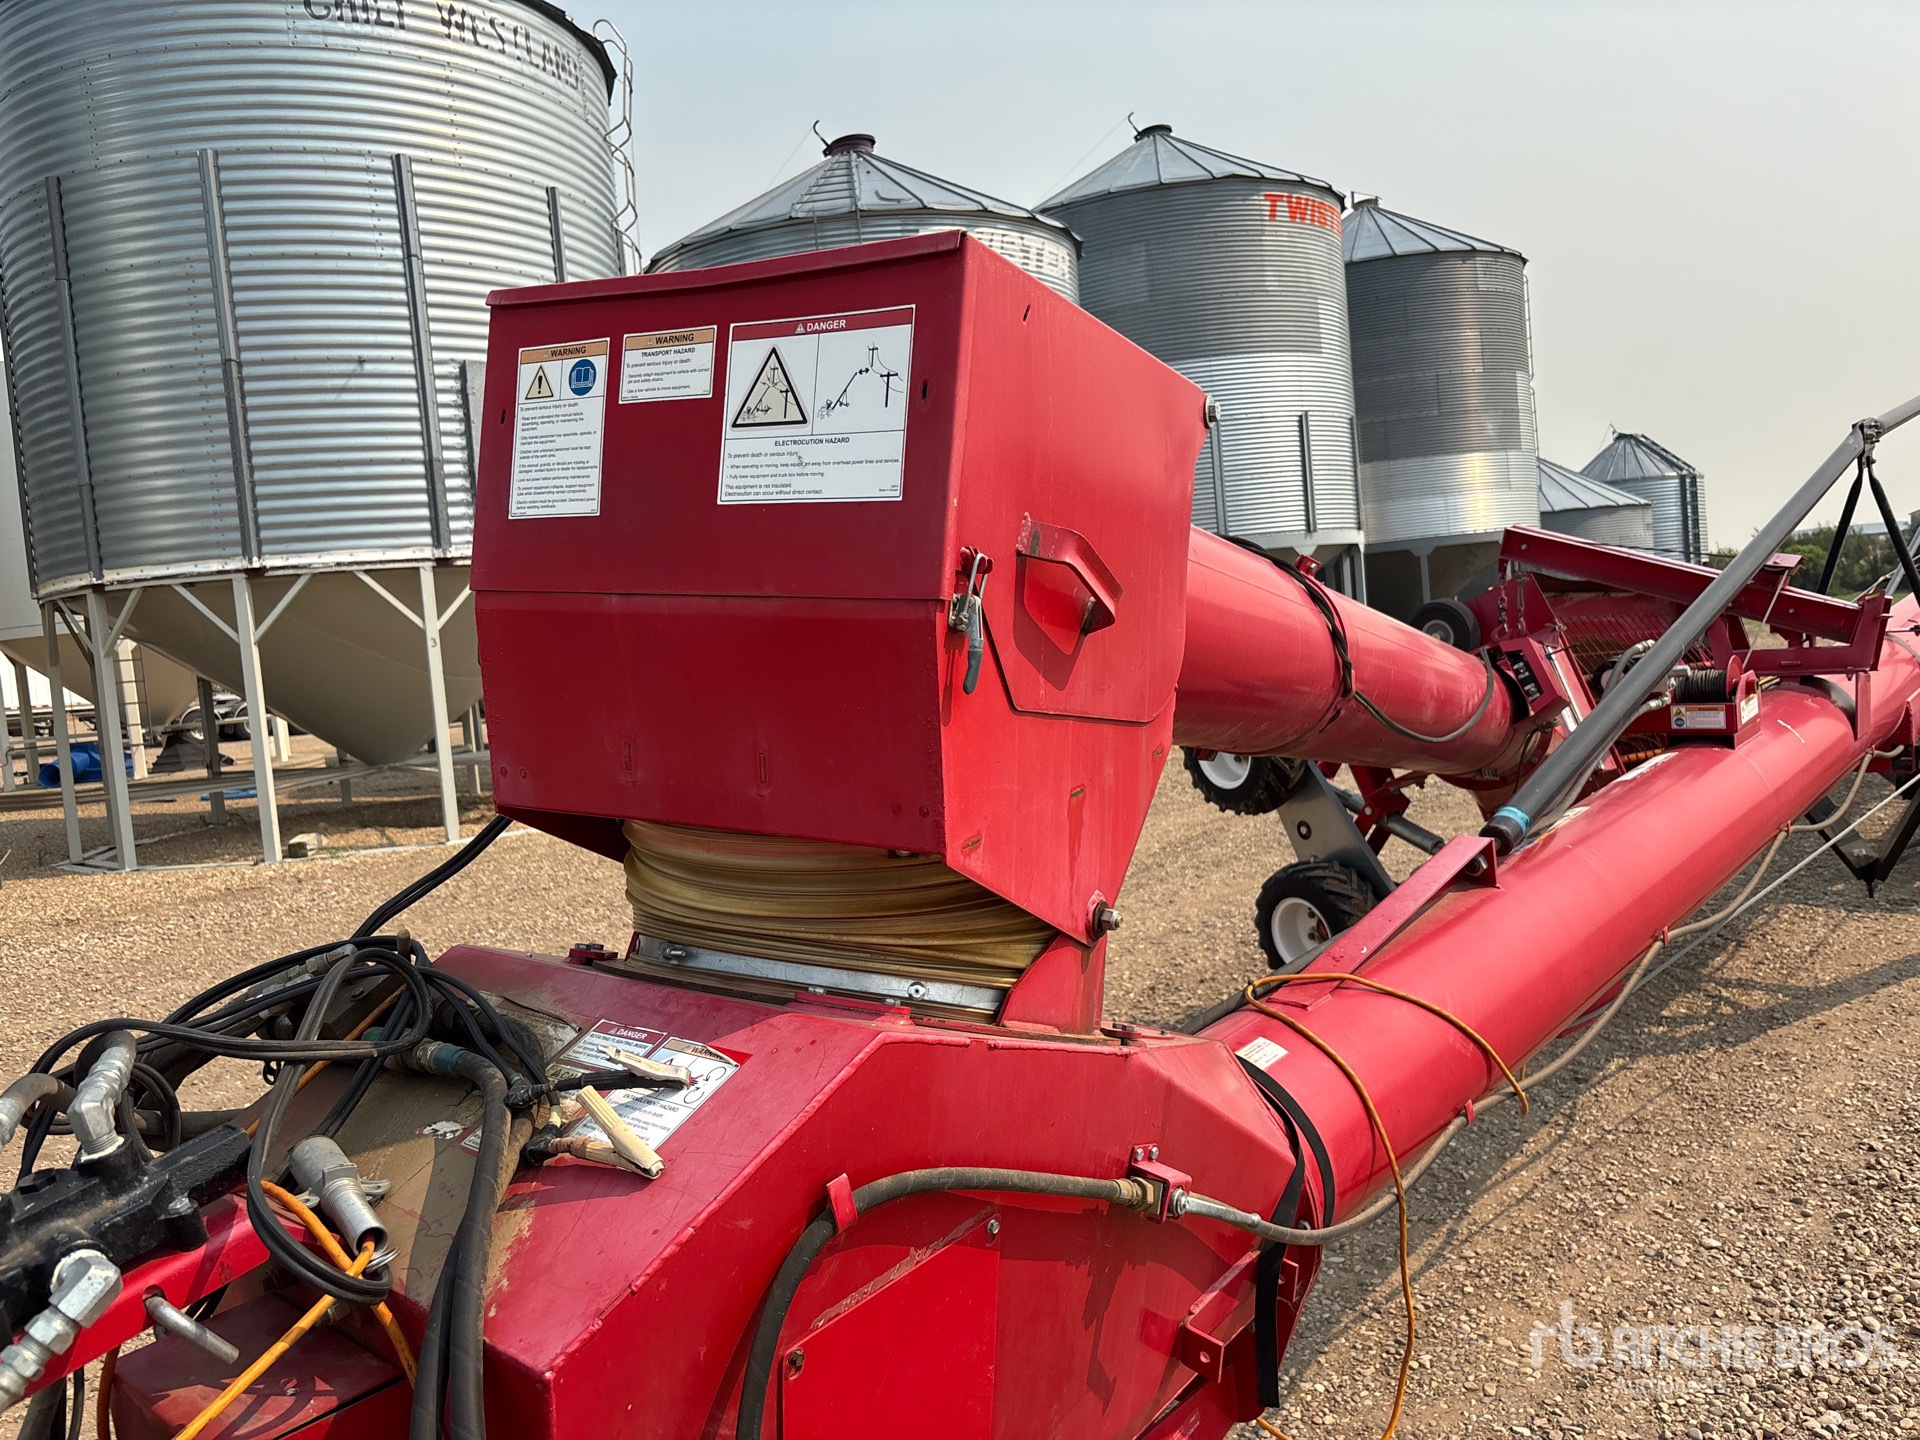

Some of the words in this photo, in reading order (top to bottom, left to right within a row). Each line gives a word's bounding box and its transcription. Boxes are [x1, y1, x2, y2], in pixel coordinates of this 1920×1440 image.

[806, 319, 846, 332] DANGER
[655, 333, 694, 345] WARNING
[550, 346, 586, 358] WARNING
[641, 349, 672, 357] TRANSPORT
[430, 637, 437, 648] 3
[617, 1029, 647, 1040] DANGER
[623, 1093, 660, 1106] ENTANGLEMENT
[658, 1104, 679, 1112] HAZARD
